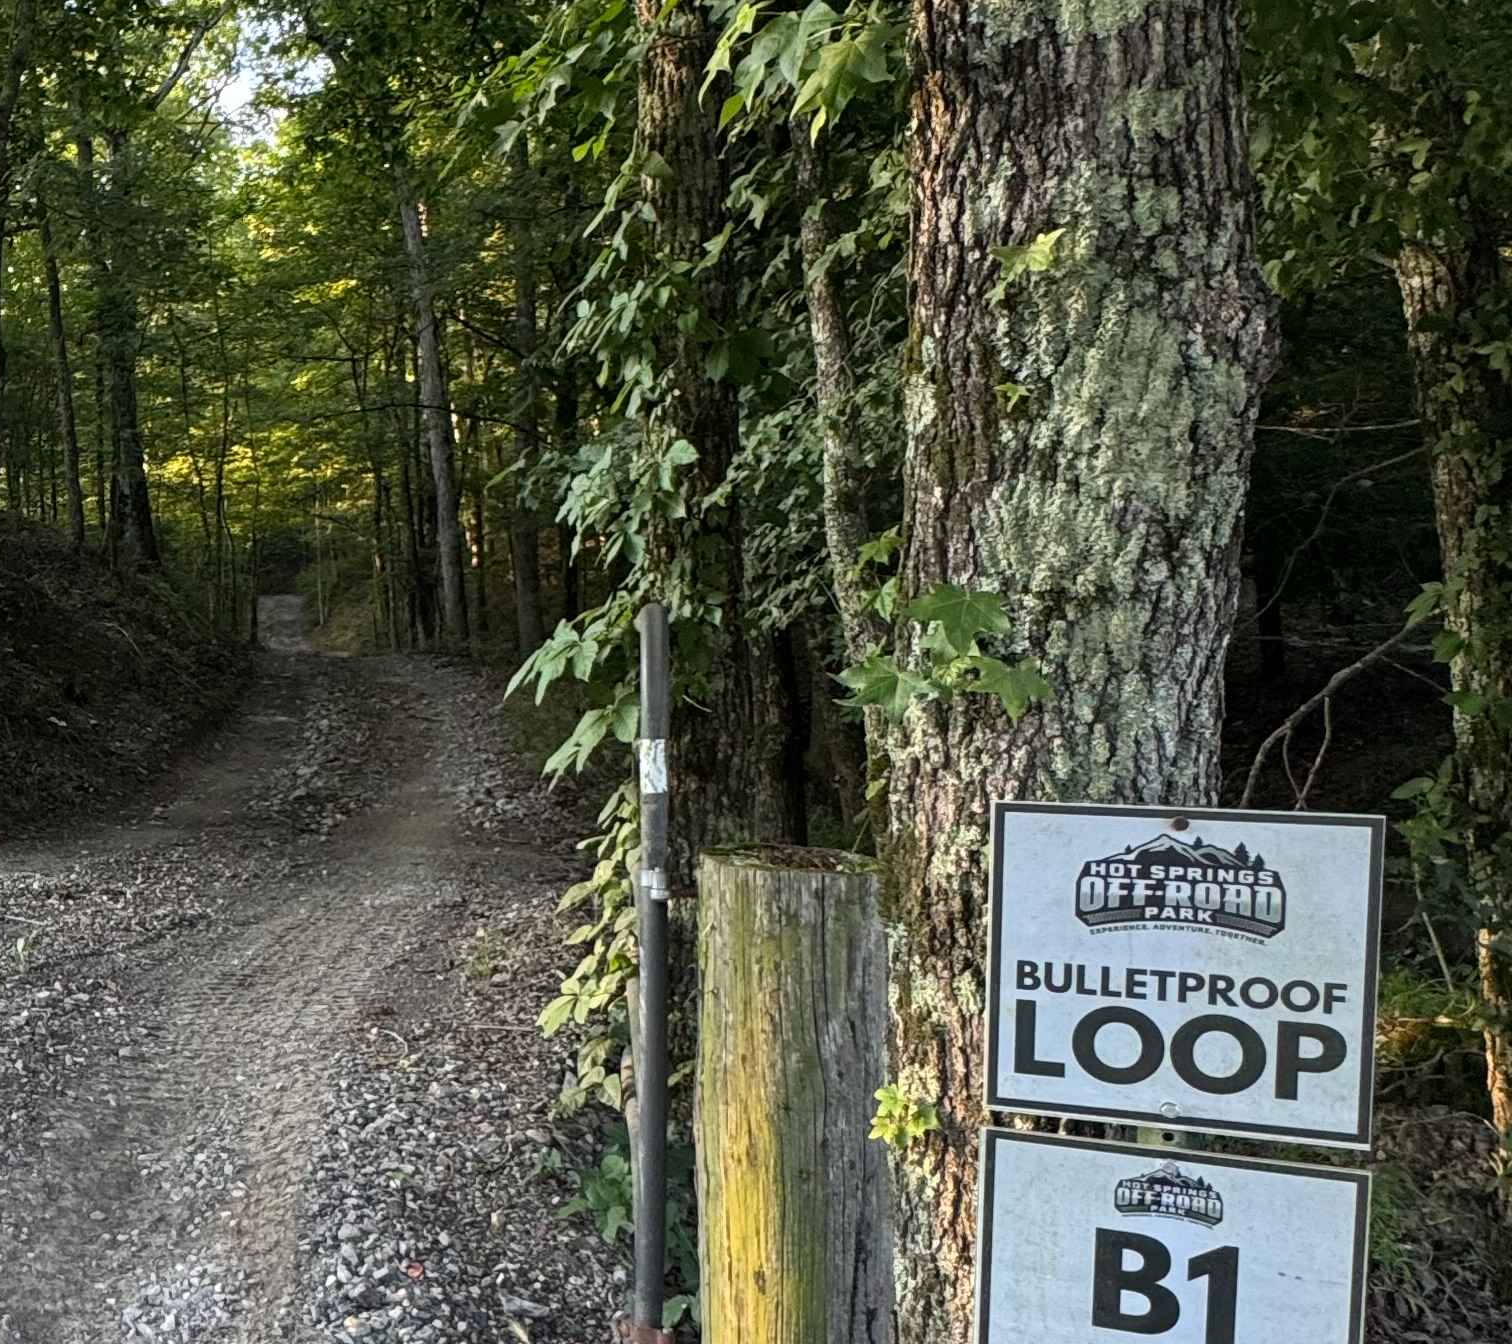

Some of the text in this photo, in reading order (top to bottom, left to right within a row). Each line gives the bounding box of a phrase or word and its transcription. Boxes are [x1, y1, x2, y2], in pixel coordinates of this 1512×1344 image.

[1090, 862, 1275, 885] HOT SPRINGS
[1078, 875, 1283, 924] OFF-ROAD
[1144, 906, 1215, 922] PARK
[1015, 959, 1348, 1015] BULLETPROOF
[1013, 999, 1348, 1101] LOOP
[1116, 1187, 1222, 1219] OFF-ROAD
[1122, 1180, 1218, 1199] HOT SPRINGS
[1150, 1204, 1187, 1216] PARK
